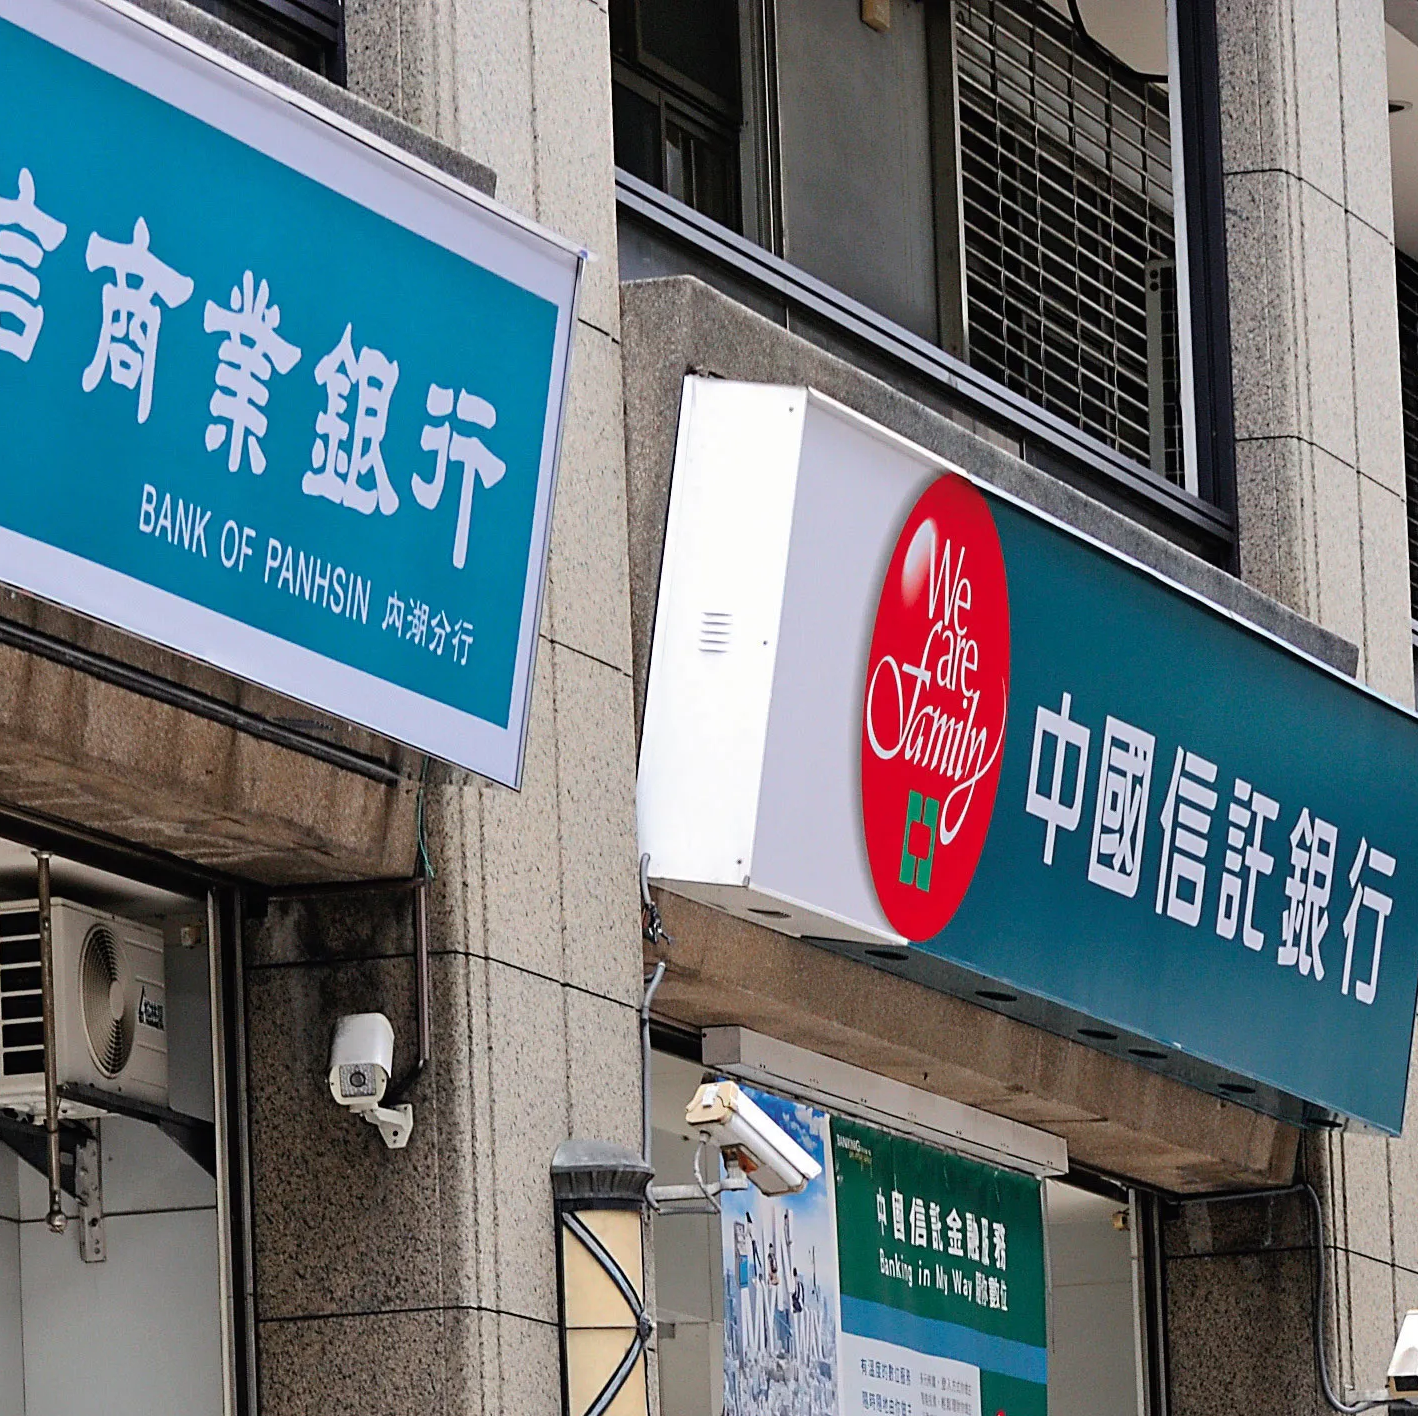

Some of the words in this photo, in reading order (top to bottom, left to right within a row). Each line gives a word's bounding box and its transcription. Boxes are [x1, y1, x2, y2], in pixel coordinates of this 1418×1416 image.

[138, 483, 209, 558] BANK
[219, 522, 253, 574] OF
[265, 536, 371, 626] PANHSIN
[927, 537, 972, 632] We
[936, 630, 979, 695] are
[867, 623, 1008, 845] Family
[1026, 692, 1397, 1006] 中國信託銀行
[876, 1187, 1007, 1272] 中國信託金融服務
[879, 1248, 913, 1287] Banking
[919, 1259, 931, 1286] in
[935, 1264, 948, 1295] My
[952, 1268, 973, 1301] Way
